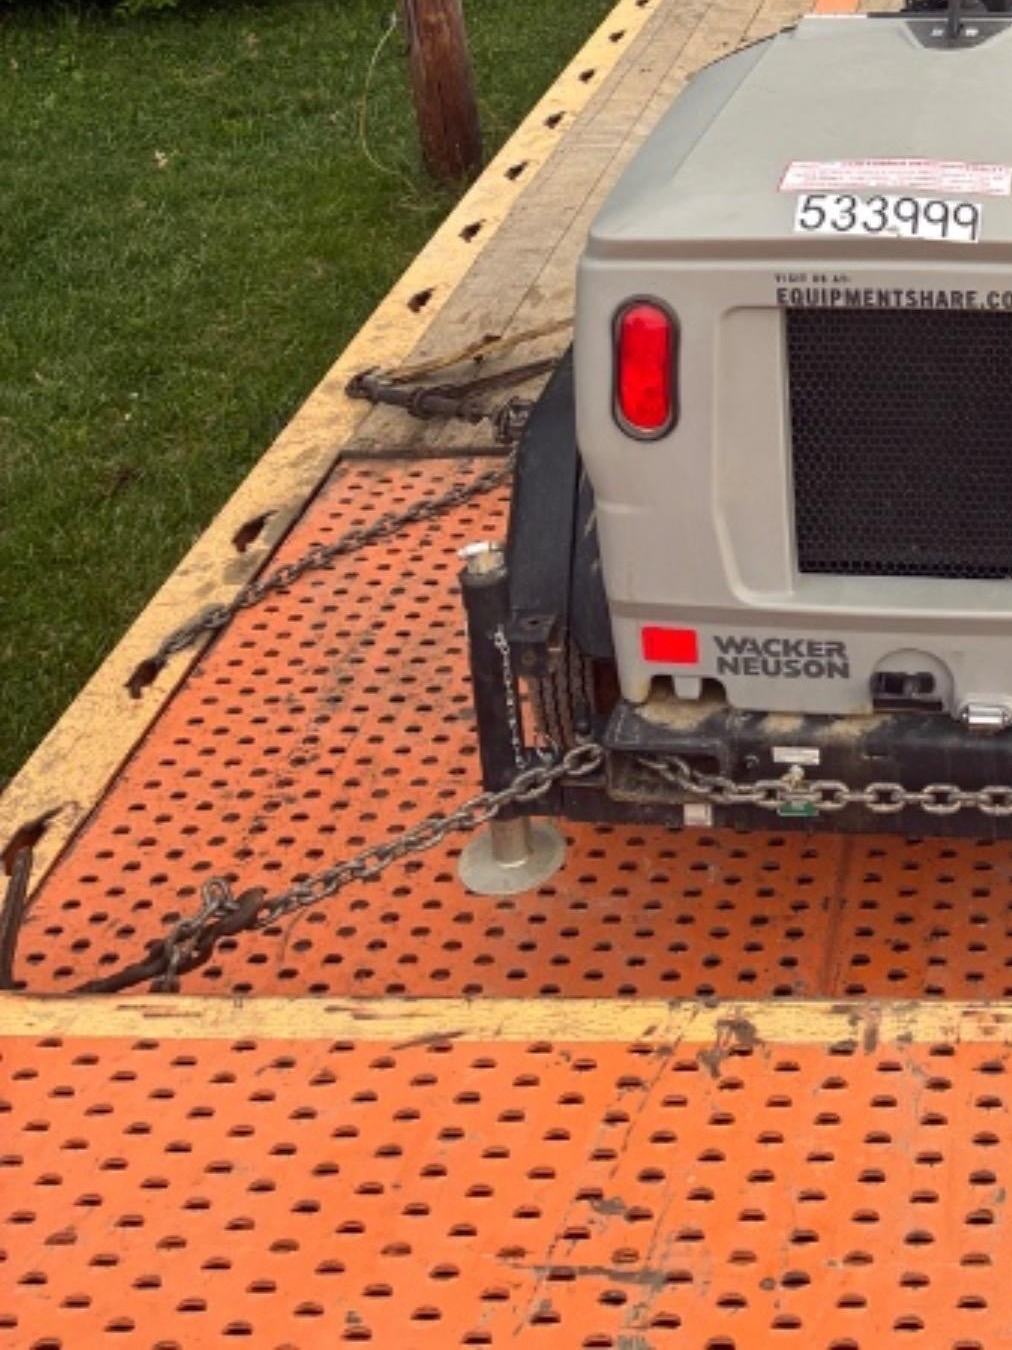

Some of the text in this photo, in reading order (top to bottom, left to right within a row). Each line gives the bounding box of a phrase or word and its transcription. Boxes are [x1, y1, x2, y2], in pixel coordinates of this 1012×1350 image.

[799, 194, 979, 241] 533999
[713, 635, 848, 660] WACKER
[716, 656, 850, 679] NEUSON
